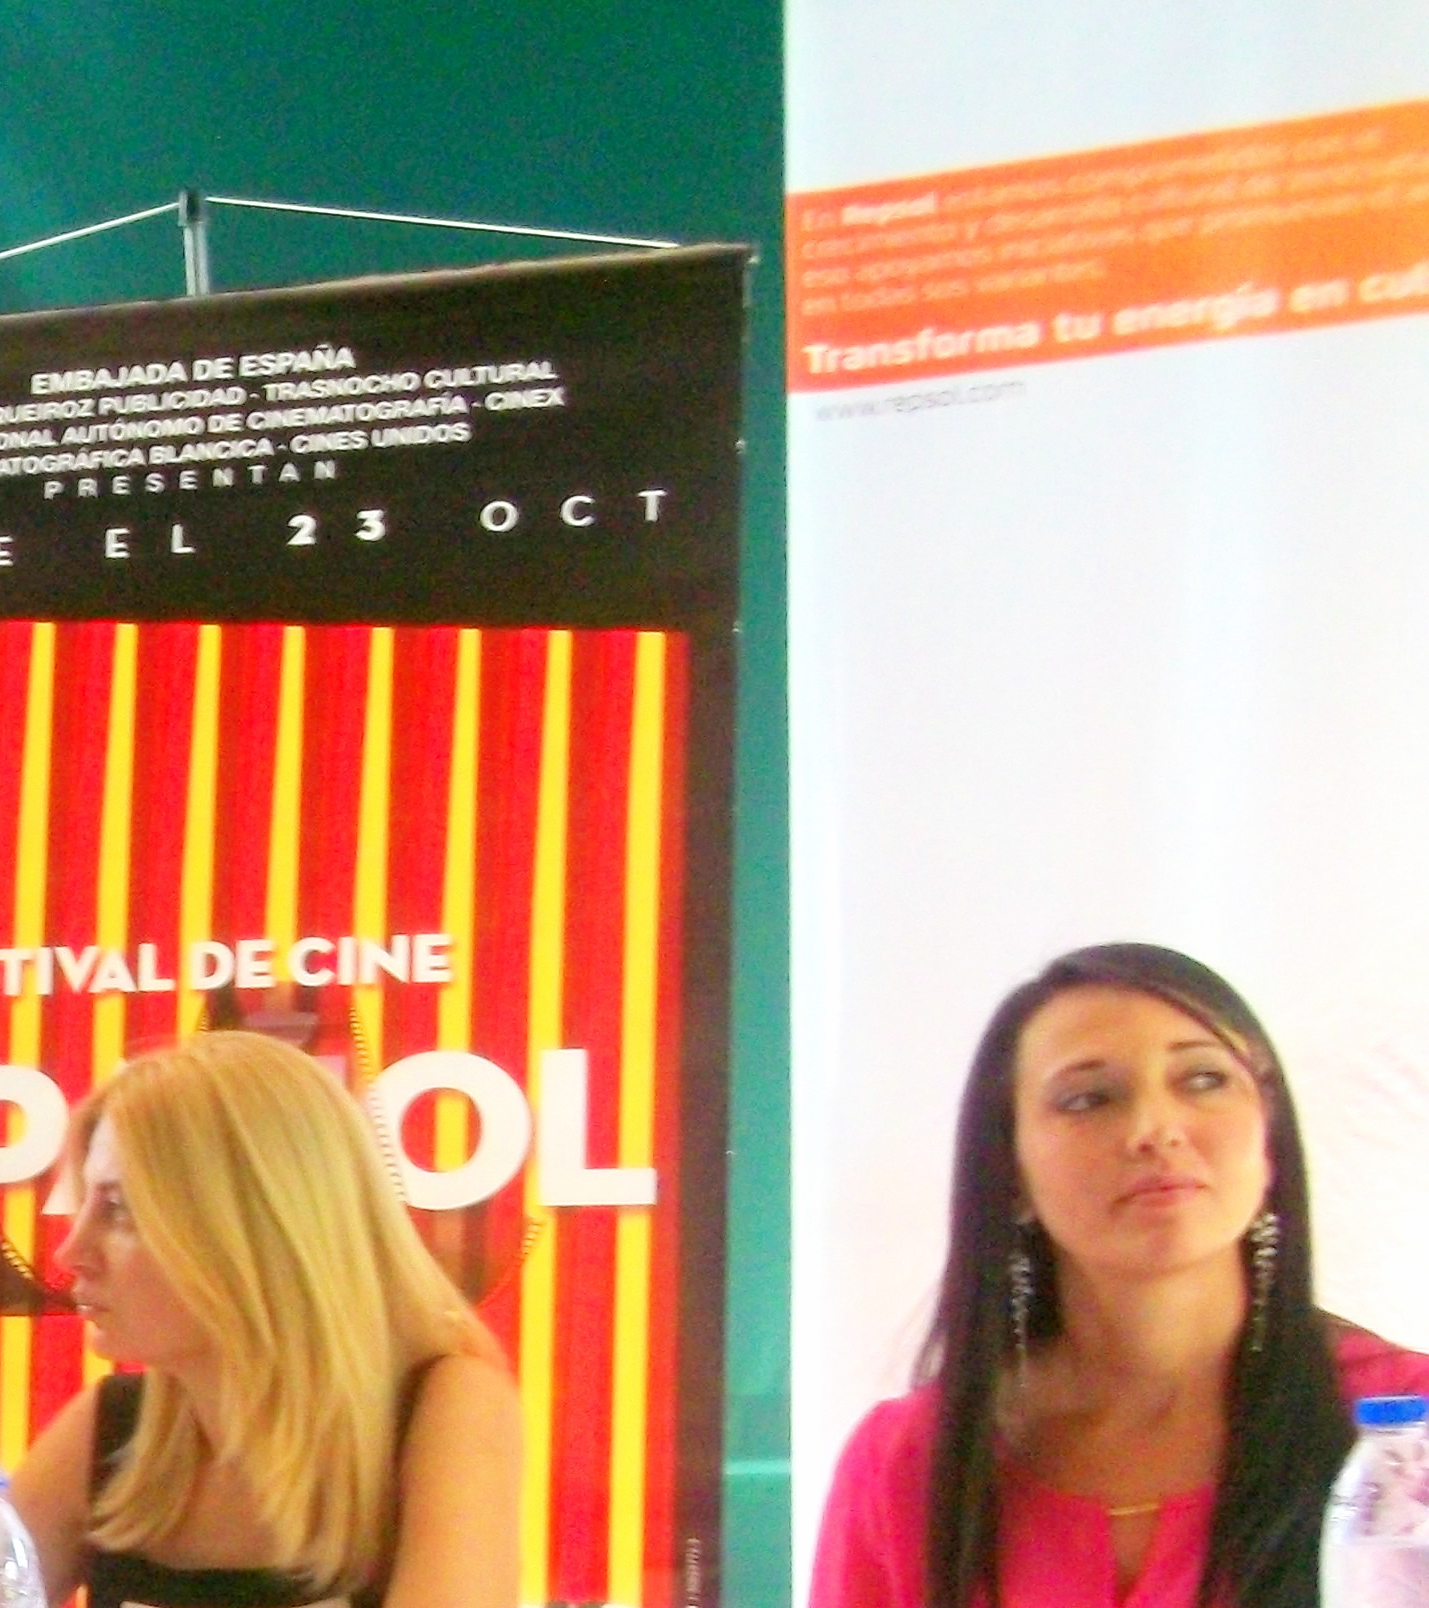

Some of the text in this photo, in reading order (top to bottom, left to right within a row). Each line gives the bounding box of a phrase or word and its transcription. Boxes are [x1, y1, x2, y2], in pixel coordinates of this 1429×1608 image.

[802, 319, 1039, 374] Transforma
[1053, 309, 1102, 342] tu
[1112, 283, 1280, 332] energía
[30, 343, 357, 395] EMBAJADA DE ESPAÑA
[98, 386, 246, 415] PUBLICIDAD
[262, 371, 421, 402] TRASNOCHO
[423, 360, 558, 389] CULTURAL
[61, 417, 205, 446] AUTÓNOMO
[207, 413, 244, 433] DE
[246, 391, 470, 430] CINEMATOGRAFÍA
[484, 385, 565, 411] CINEX
[148, 437, 275, 466] BLANCICA
[289, 430, 369, 454] CINES
[370, 422, 472, 448] UNIDOS
[44, 459, 337, 500] PRESENTAN
[104, 523, 196, 560] EL
[286, 509, 387, 546] 23
[480, 488, 668, 532] OCT
[189, 938, 278, 991] DE
[287, 932, 453, 988] CINE
